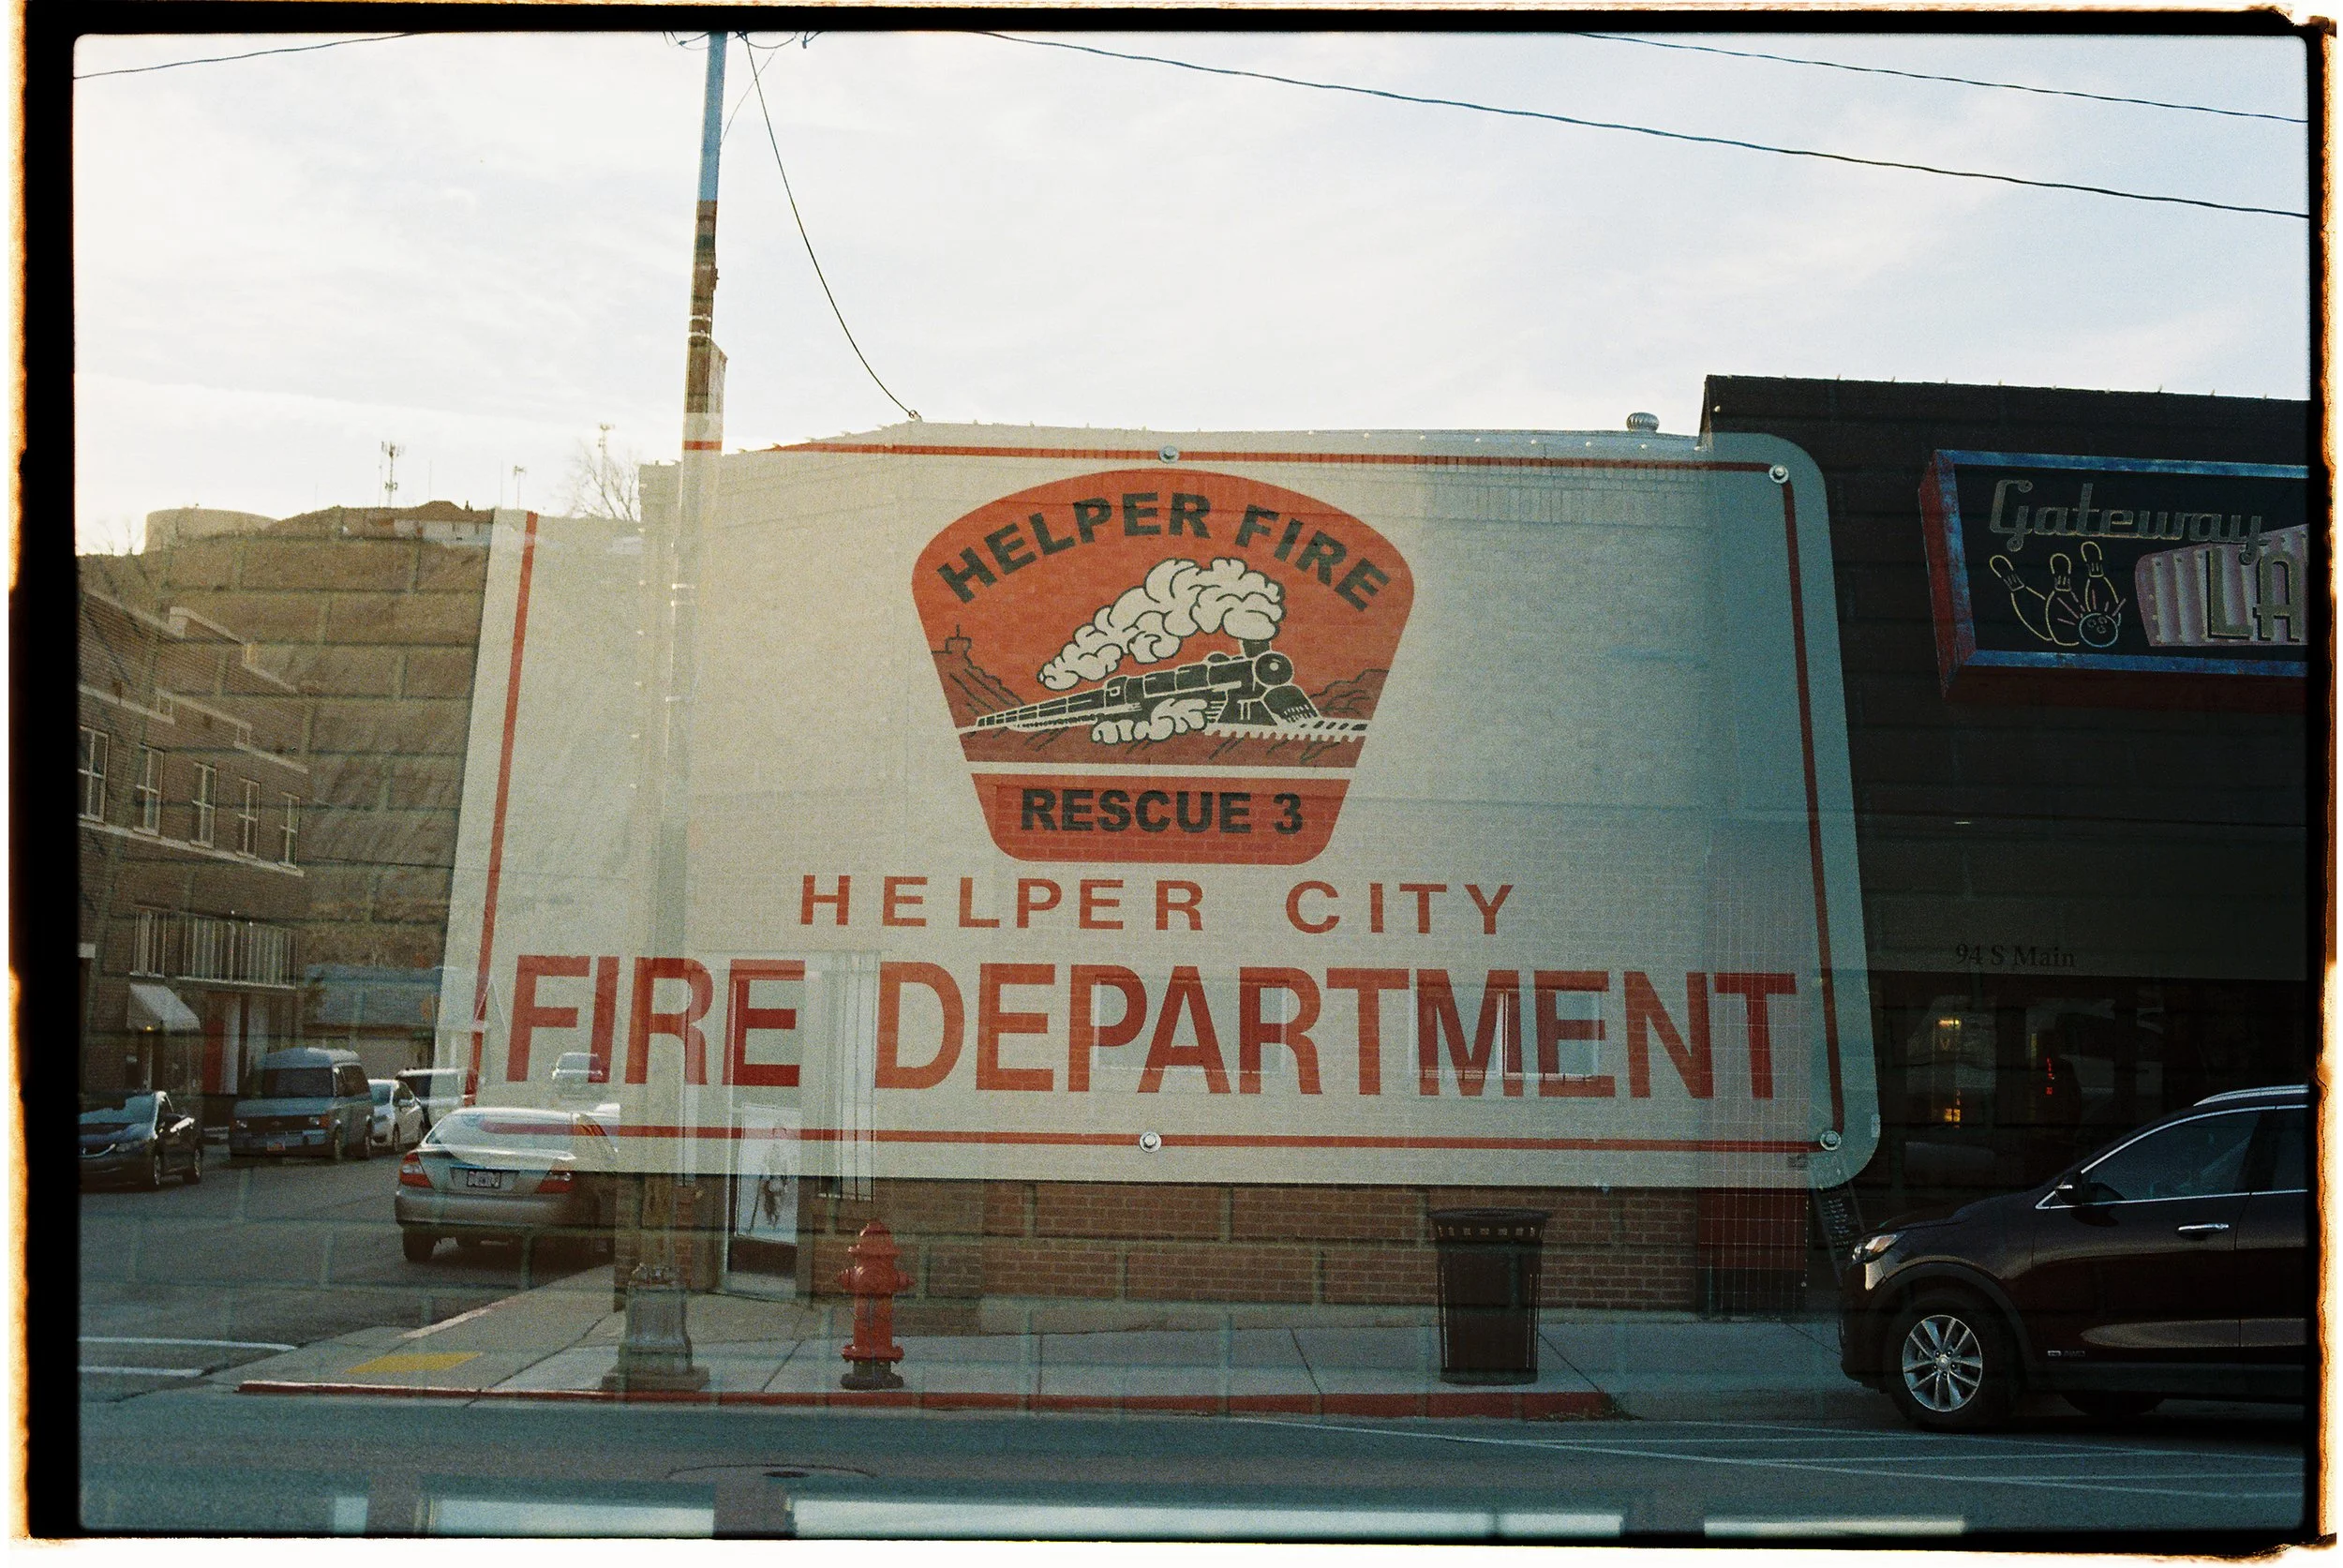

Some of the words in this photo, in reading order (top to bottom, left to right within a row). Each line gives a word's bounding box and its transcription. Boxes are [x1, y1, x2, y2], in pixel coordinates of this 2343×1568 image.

[937, 492, 1211, 604] HELPER
[1234, 503, 1391, 611] FIRE
[1989, 479, 2270, 565] Gateway
[1021, 788, 1252, 834] RESCUE
[1273, 792, 1304, 835] 3
[800, 874, 1203, 933] HELPER
[1285, 880, 1515, 935] CITY
[1955, 943, 1984, 965] 94
[1991, 944, 2005, 966] S
[2013, 945, 2077, 968] Main
[505, 954, 806, 1088] FIRE
[873, 960, 1798, 1100] DEPARTMENT
